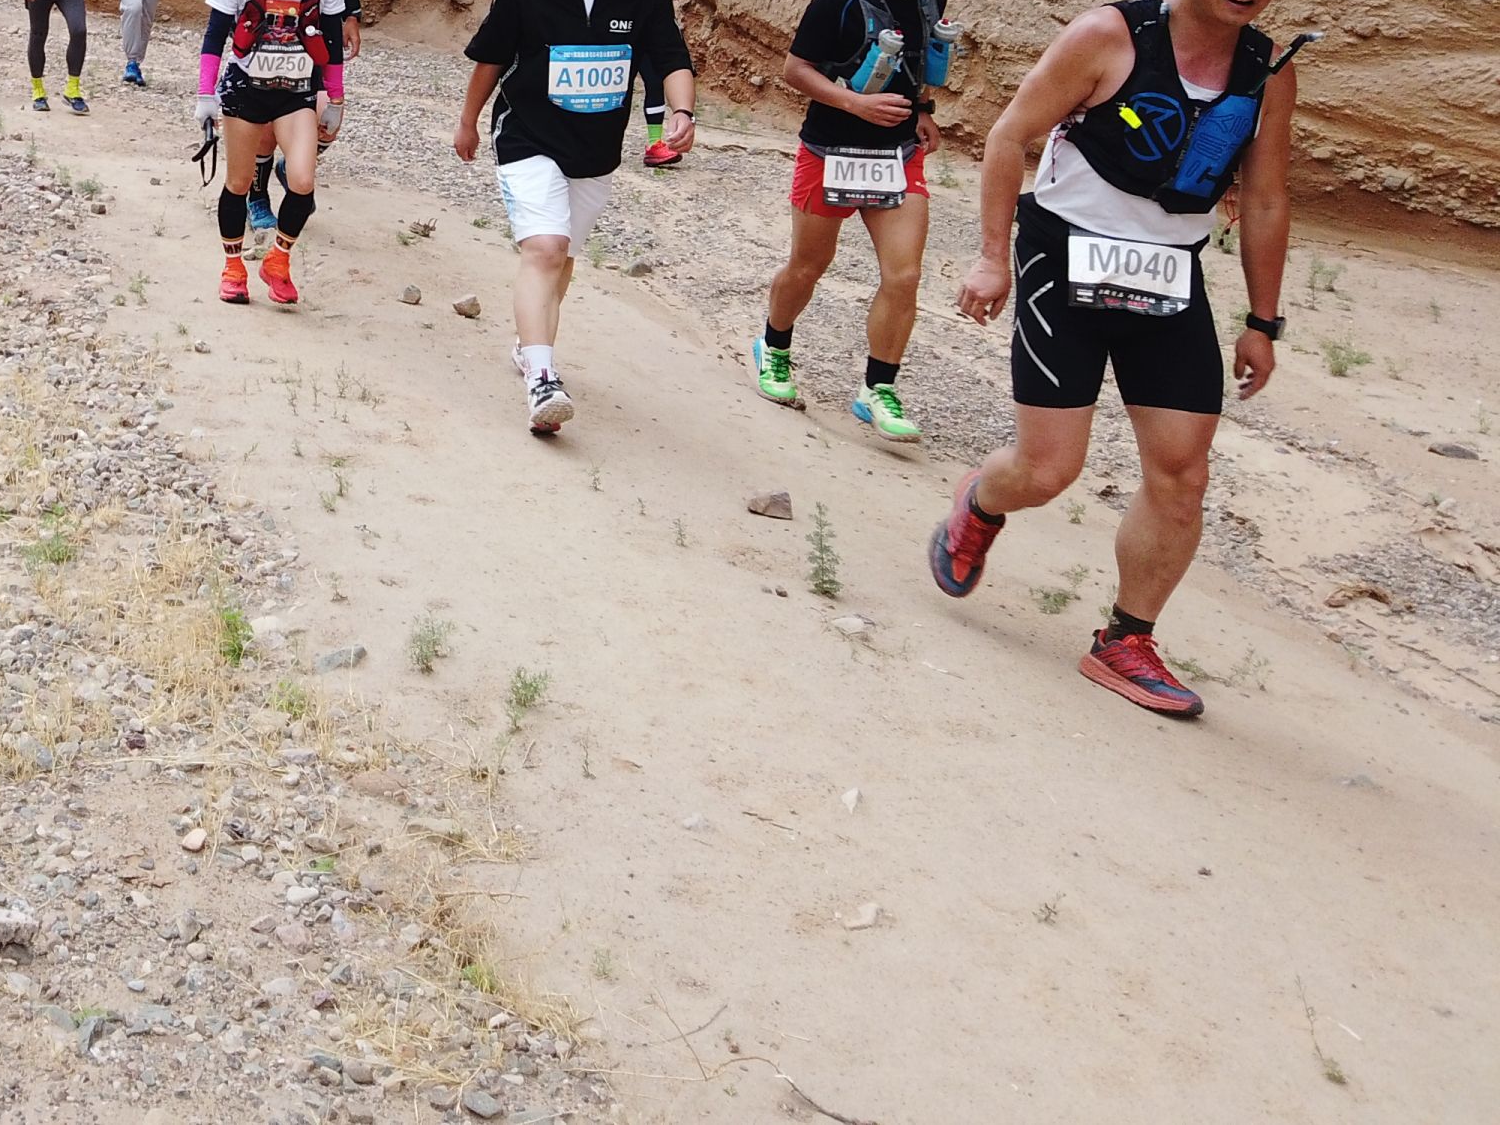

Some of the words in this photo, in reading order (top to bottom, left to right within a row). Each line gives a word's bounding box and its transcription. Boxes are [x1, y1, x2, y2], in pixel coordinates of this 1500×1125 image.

[609, 19, 633, 30] ONE
[256, 56, 306, 72] W250
[556, 66, 624, 88] A1003
[834, 160, 894, 183] M161
[1088, 243, 1177, 284] M040
